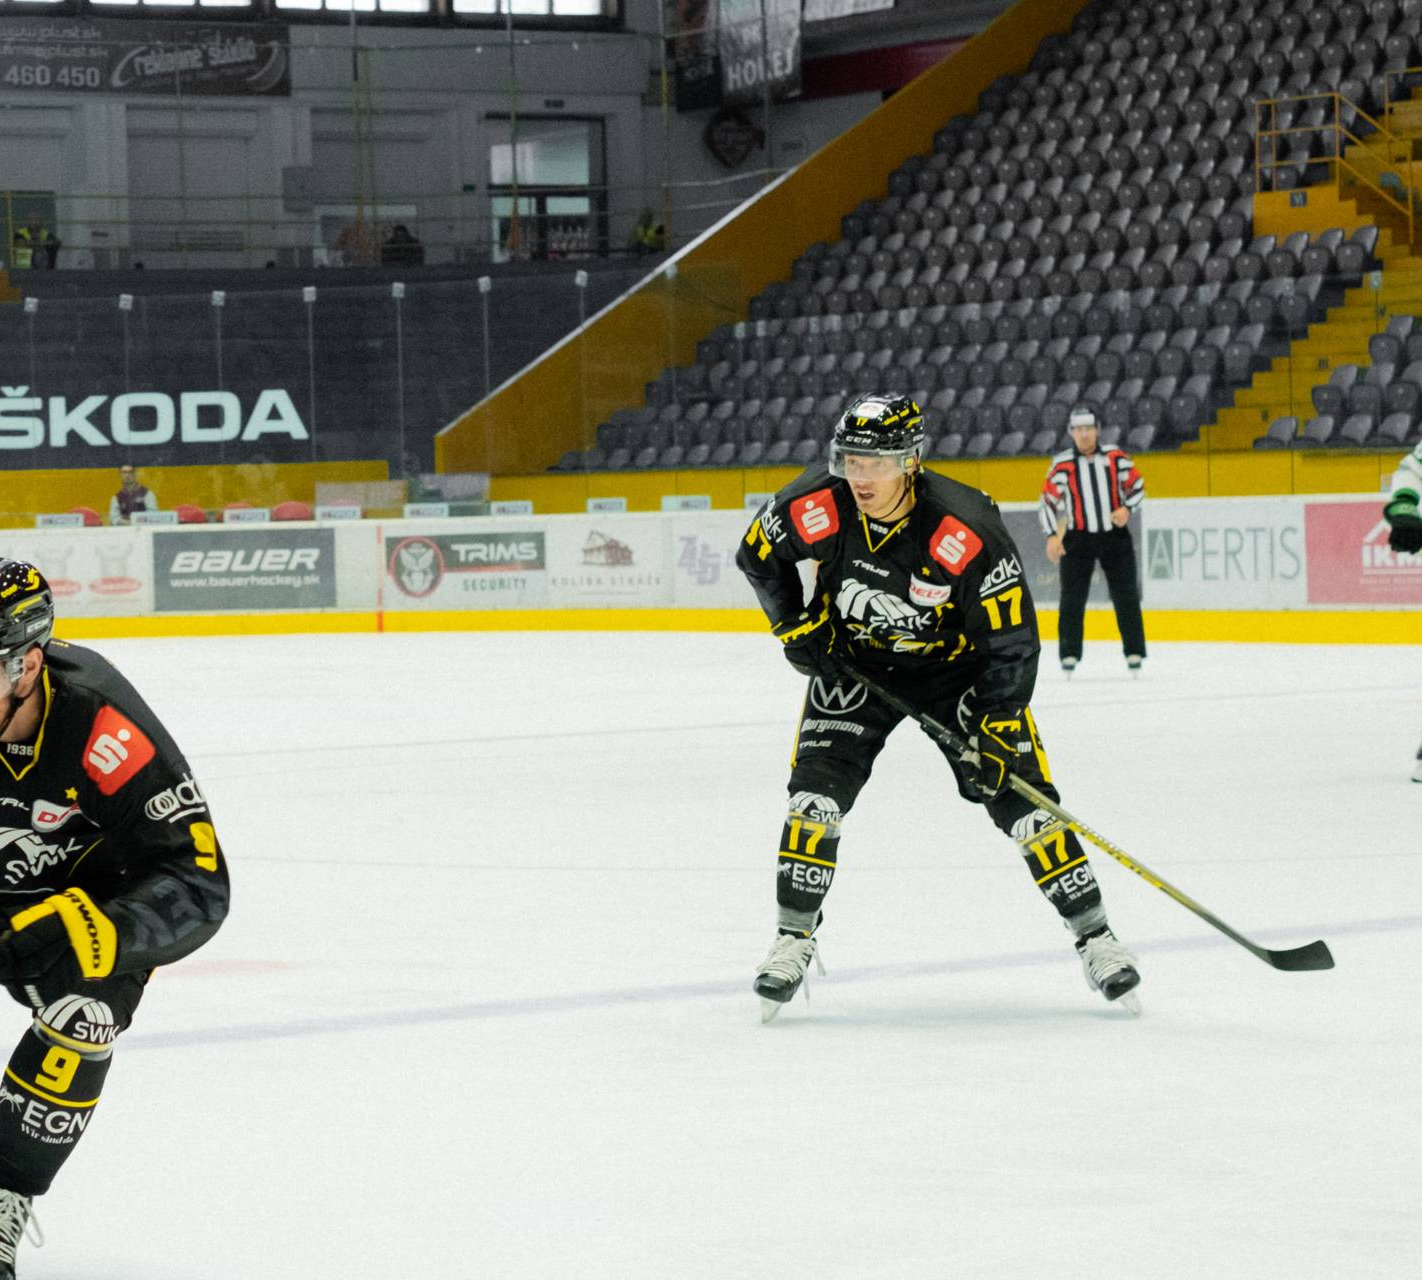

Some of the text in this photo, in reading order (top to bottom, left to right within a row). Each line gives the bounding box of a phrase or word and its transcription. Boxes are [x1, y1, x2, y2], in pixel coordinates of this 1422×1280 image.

[5, 65, 51, 85] 460
[57, 67, 100, 86] 450
[170, 548, 321, 573] BAUER
[450, 542, 538, 563] TRIMS
[1148, 526, 1300, 581] APERTIS
[170, 573, 321, 589] www.bauerhockey.sk
[981, 586, 1023, 630] 17
[7, 743, 34, 756] 1936
[788, 818, 827, 856] 17
[1029, 829, 1070, 873] 17
[792, 863, 833, 888] EGN
[72, 1020, 120, 1044] SWK
[35, 1045, 81, 1094] 9
[22, 1099, 92, 1136] EGN
